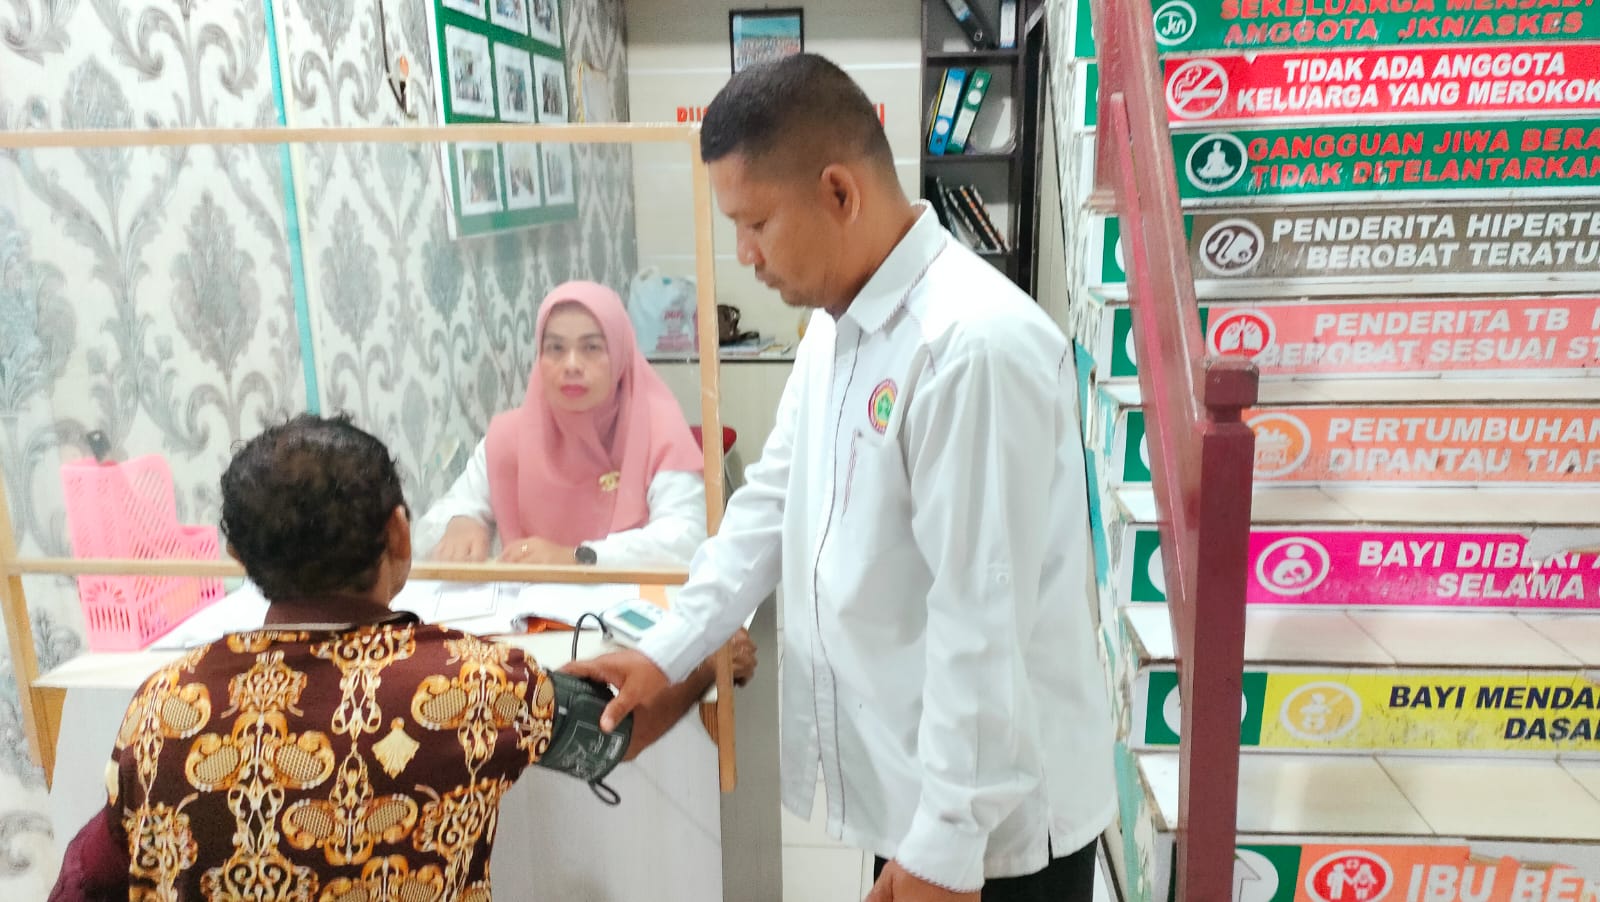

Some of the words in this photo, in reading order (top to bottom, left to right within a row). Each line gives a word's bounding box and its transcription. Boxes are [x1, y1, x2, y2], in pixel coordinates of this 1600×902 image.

[1220, 0, 1434, 20] SEKELUARGA
[1223, 18, 1378, 45] ANGGOTA
[1397, 11, 1584, 38] JKN/ASKES
[1283, 57, 1365, 84] TIDAK
[1370, 55, 1426, 80] ADA
[1431, 51, 1565, 79] ANGGOTA
[1236, 83, 1379, 112] KELUARGA
[1388, 81, 1460, 107] YANG
[1466, 78, 1600, 106] MEROKOK
[1247, 131, 1425, 162] GANGGUAN
[1433, 128, 1510, 154] JIWA
[1250, 161, 1343, 189] TIDAK
[1272, 213, 1456, 244] PENDERITA
[1306, 242, 1459, 270] BEROBAT
[1469, 239, 1600, 267] TERATU
[1314, 309, 1511, 337] PENDERITA
[1523, 307, 1570, 333] TB
[1429, 336, 1557, 363] SESUAI
[1328, 447, 1512, 474] DIPANTAU
[1358, 540, 1445, 568] BAYI
[1436, 571, 1585, 600] SELAMA
[1388, 685, 1467, 709] BAYI
[1475, 686, 1600, 710] MENDA
[1503, 717, 1600, 741] DASA
[1406, 863, 1497, 902] IBU
